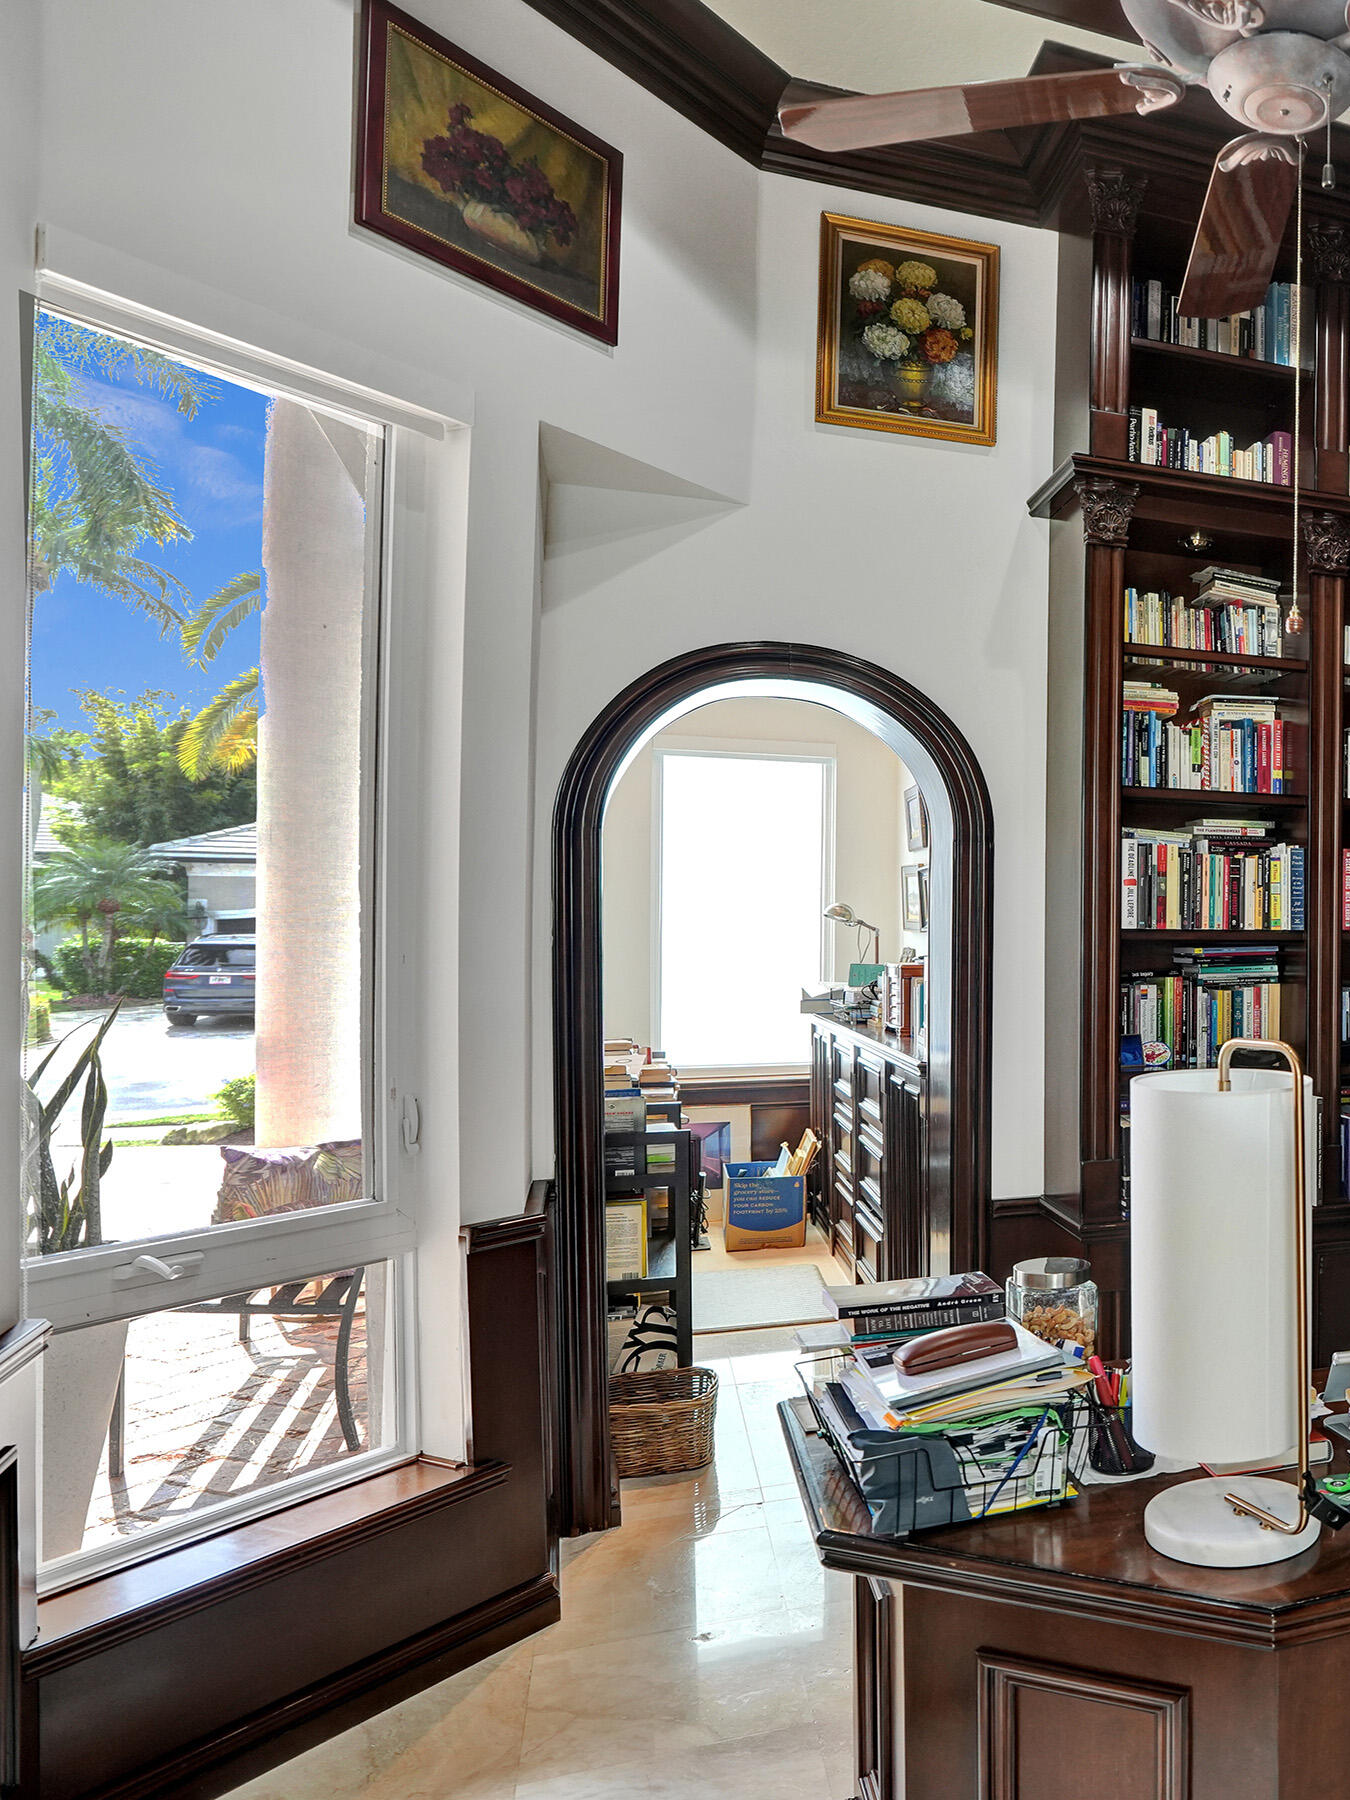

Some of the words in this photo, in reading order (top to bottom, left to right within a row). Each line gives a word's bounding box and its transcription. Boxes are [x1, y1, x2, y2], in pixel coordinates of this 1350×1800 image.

[1126, 843, 1136, 853] THE
[1126, 853, 1136, 877] DEADLINE
[1126, 886, 1135, 898] JILL
[1126, 899, 1135, 919] LEPORE
[902, 1303, 930, 1311] NEGATIVE
[937, 1300, 959, 1308] André
